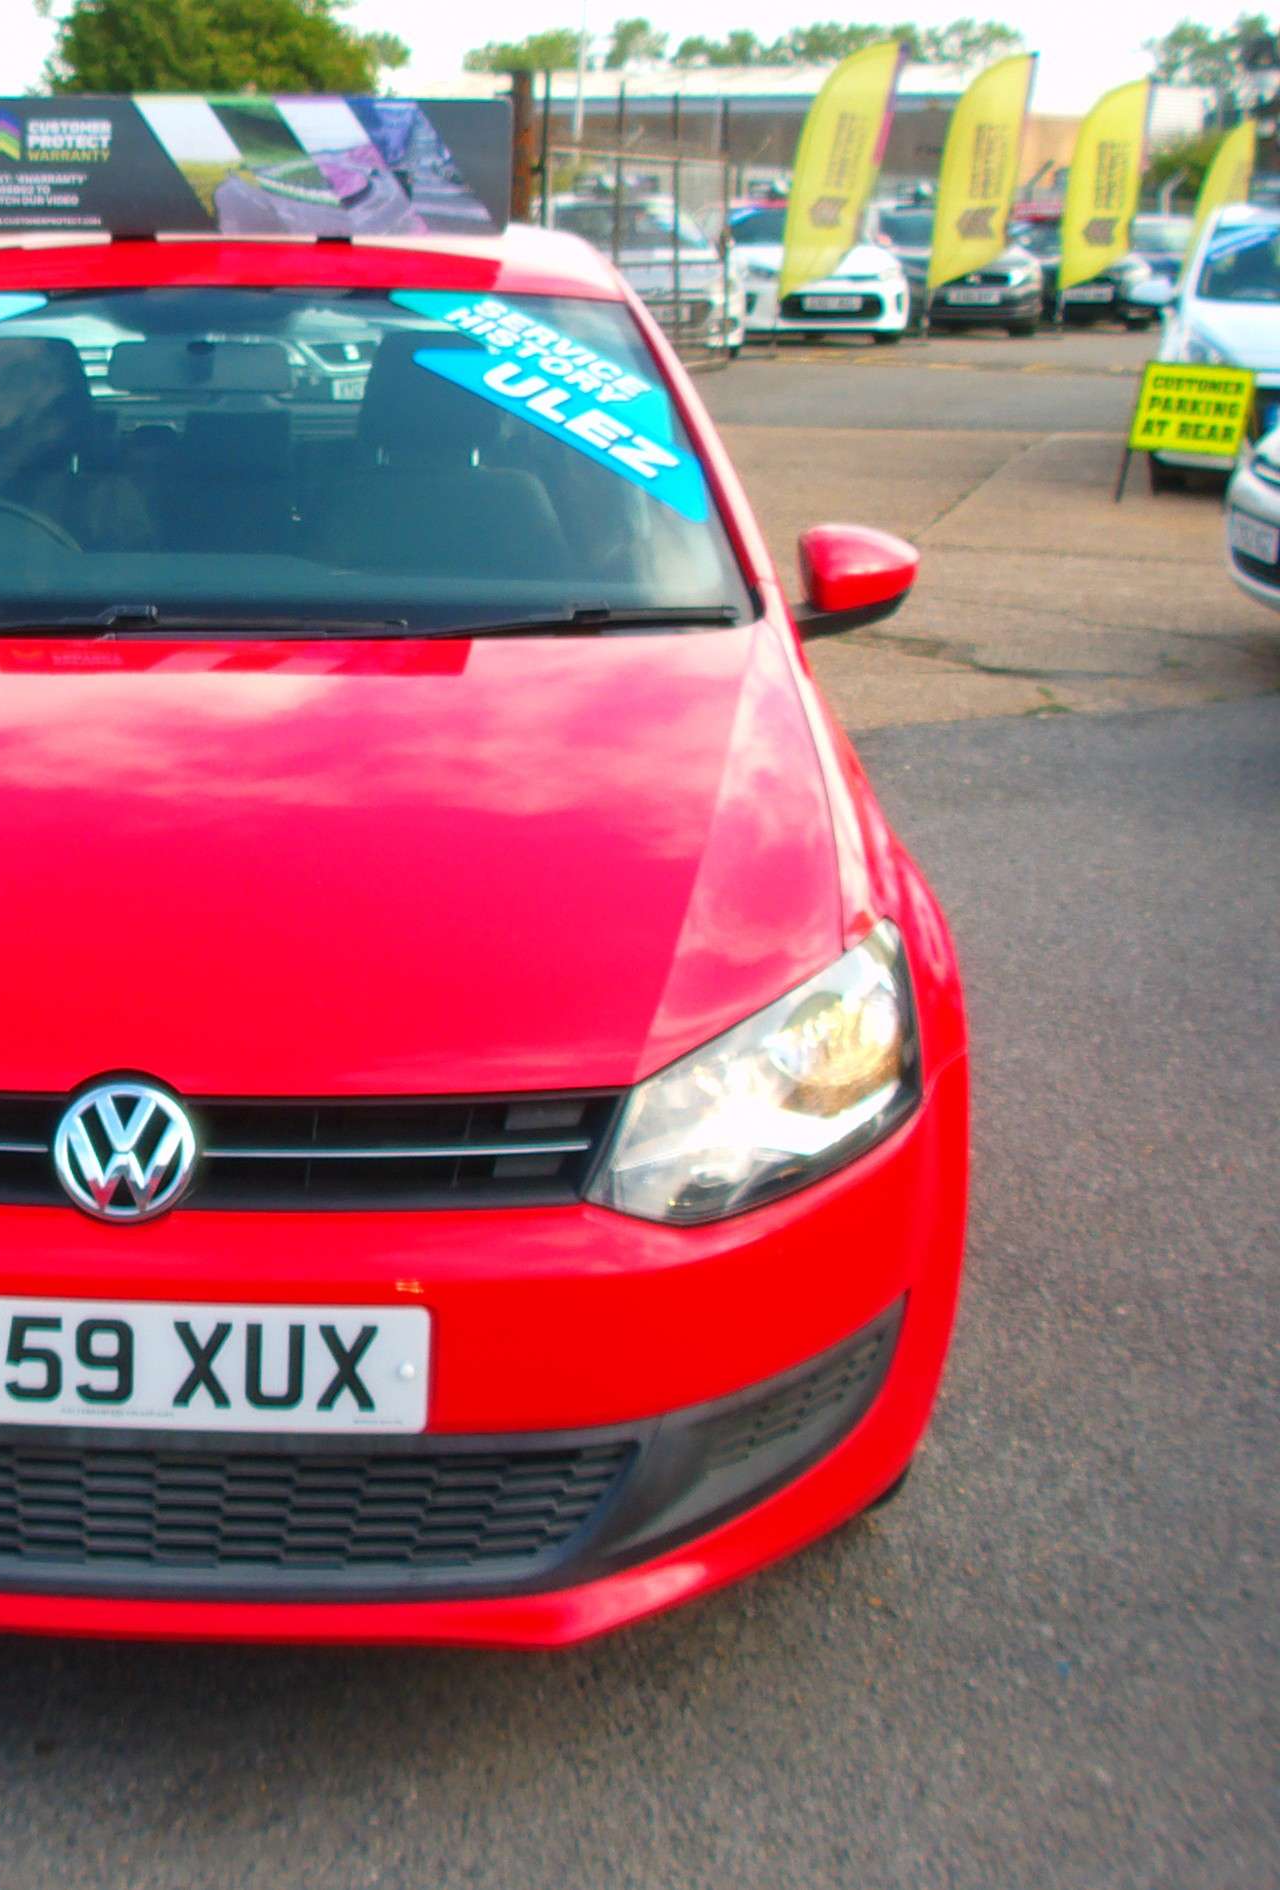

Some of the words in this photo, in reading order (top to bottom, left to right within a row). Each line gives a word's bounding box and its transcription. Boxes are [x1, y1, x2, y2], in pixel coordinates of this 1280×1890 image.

[27, 119, 112, 135] CUSTOMER
[27, 135, 111, 149] PROTECT
[27, 150, 111, 161] WARRANTY
[22, 195, 45, 206] OUR
[47, 195, 80, 206] VIDEO
[36, 185, 51, 195] TO
[443, 306, 637, 404] HISTORY
[473, 299, 653, 399] SERVICE
[1153, 375, 1245, 395] CUSTOMER
[1149, 395, 1242, 418] PARKING
[483, 361, 681, 480] ULEZ
[1140, 417, 1173, 437] AT
[1177, 420, 1236, 444] REAR
[172, 1319, 380, 1412] XUX
